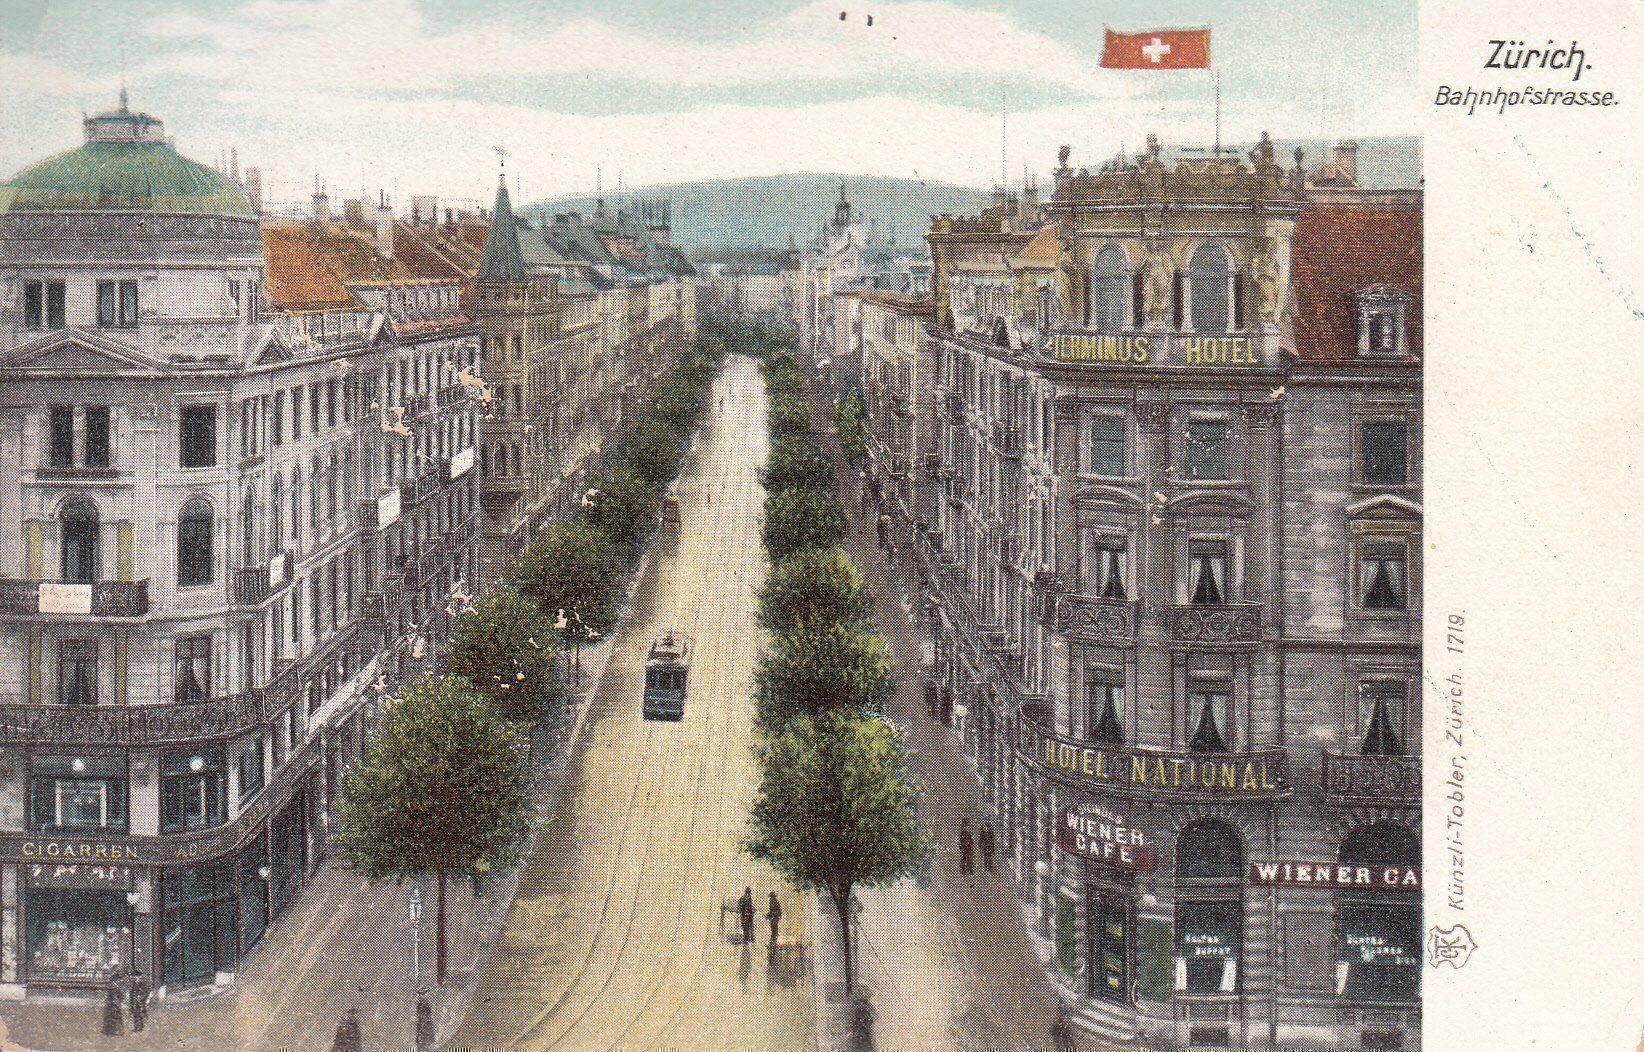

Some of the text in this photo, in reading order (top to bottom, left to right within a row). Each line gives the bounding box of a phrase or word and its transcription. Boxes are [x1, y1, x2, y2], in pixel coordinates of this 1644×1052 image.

[1054, 334, 1258, 365] TERMINUS HOTEL
[1045, 739, 1274, 791] HOTEL NATIONAL
[1066, 811, 1144, 847] WIENER
[22, 842, 138, 858] CIGARREN
[1256, 864, 1419, 886] WIENER CA
